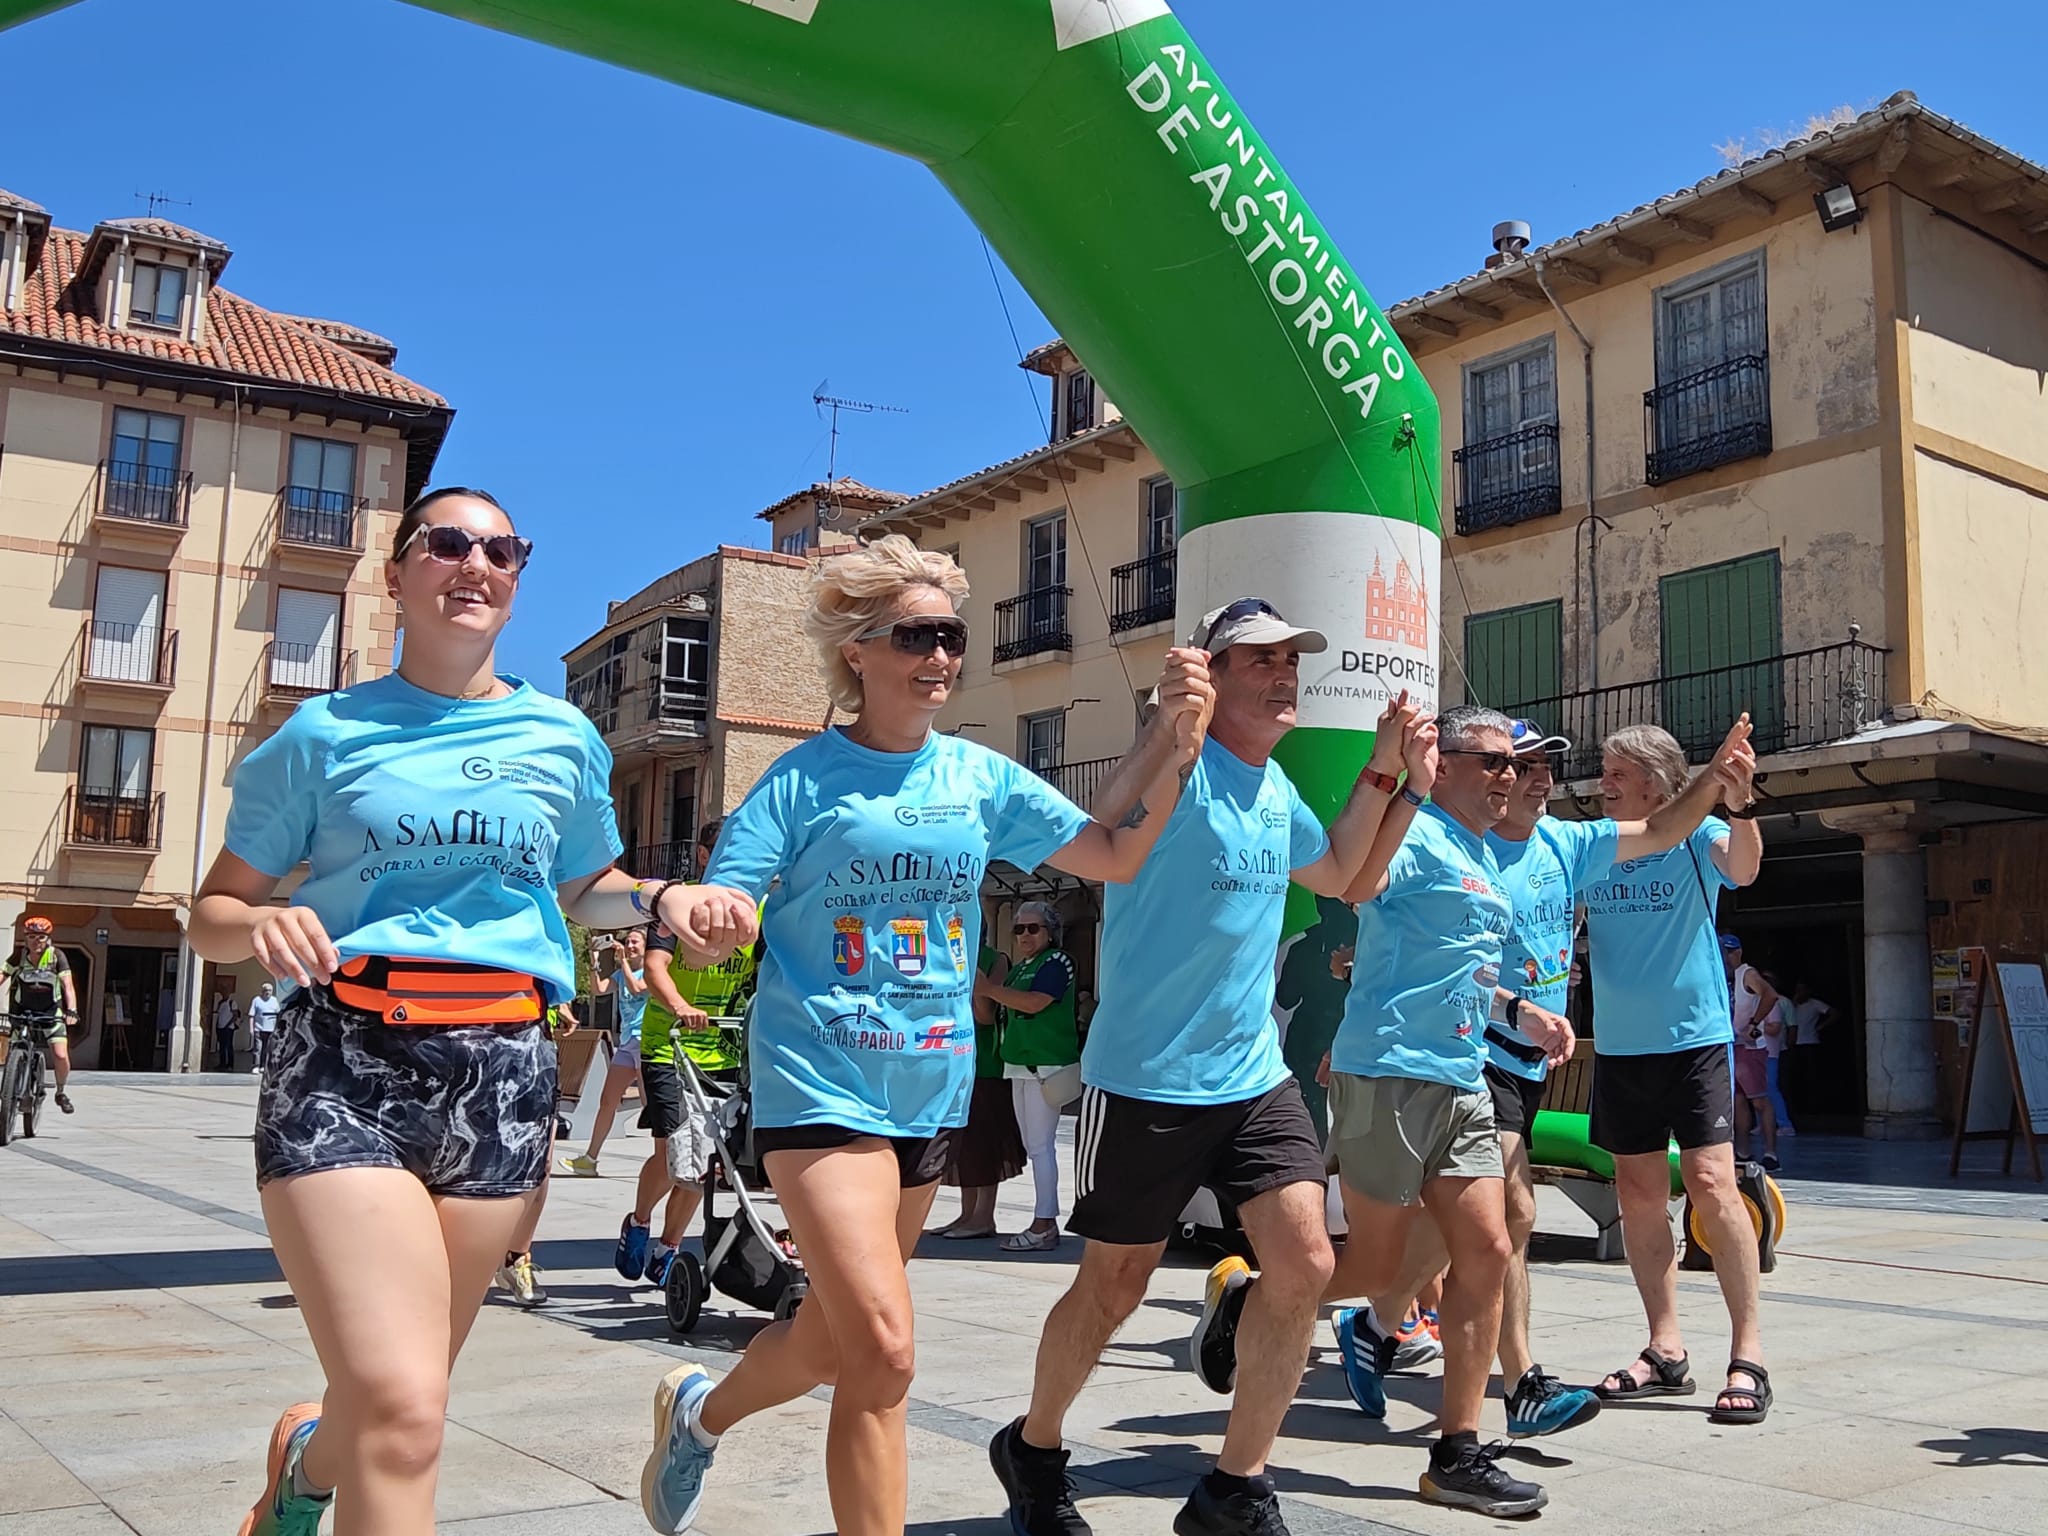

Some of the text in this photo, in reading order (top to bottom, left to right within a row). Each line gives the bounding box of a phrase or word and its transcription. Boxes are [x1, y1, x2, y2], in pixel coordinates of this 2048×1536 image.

[1160, 43, 1405, 381] AYUNTAMIENTO
[1126, 61, 1382, 418] DE ASTORGA
[1341, 650, 1435, 689] DEPORTES
[1304, 685, 1400, 703] AYUNTAMIENT
[362, 826, 383, 854] A
[433, 852, 452, 866] el
[509, 866, 545, 889] 2025
[1215, 853, 1230, 871] A
[824, 871, 841, 888] A
[1253, 880, 1263, 894] el
[880, 887, 894, 904] el
[1651, 902, 1674, 912] 2025
[857, 1030, 906, 1050] PABLO
